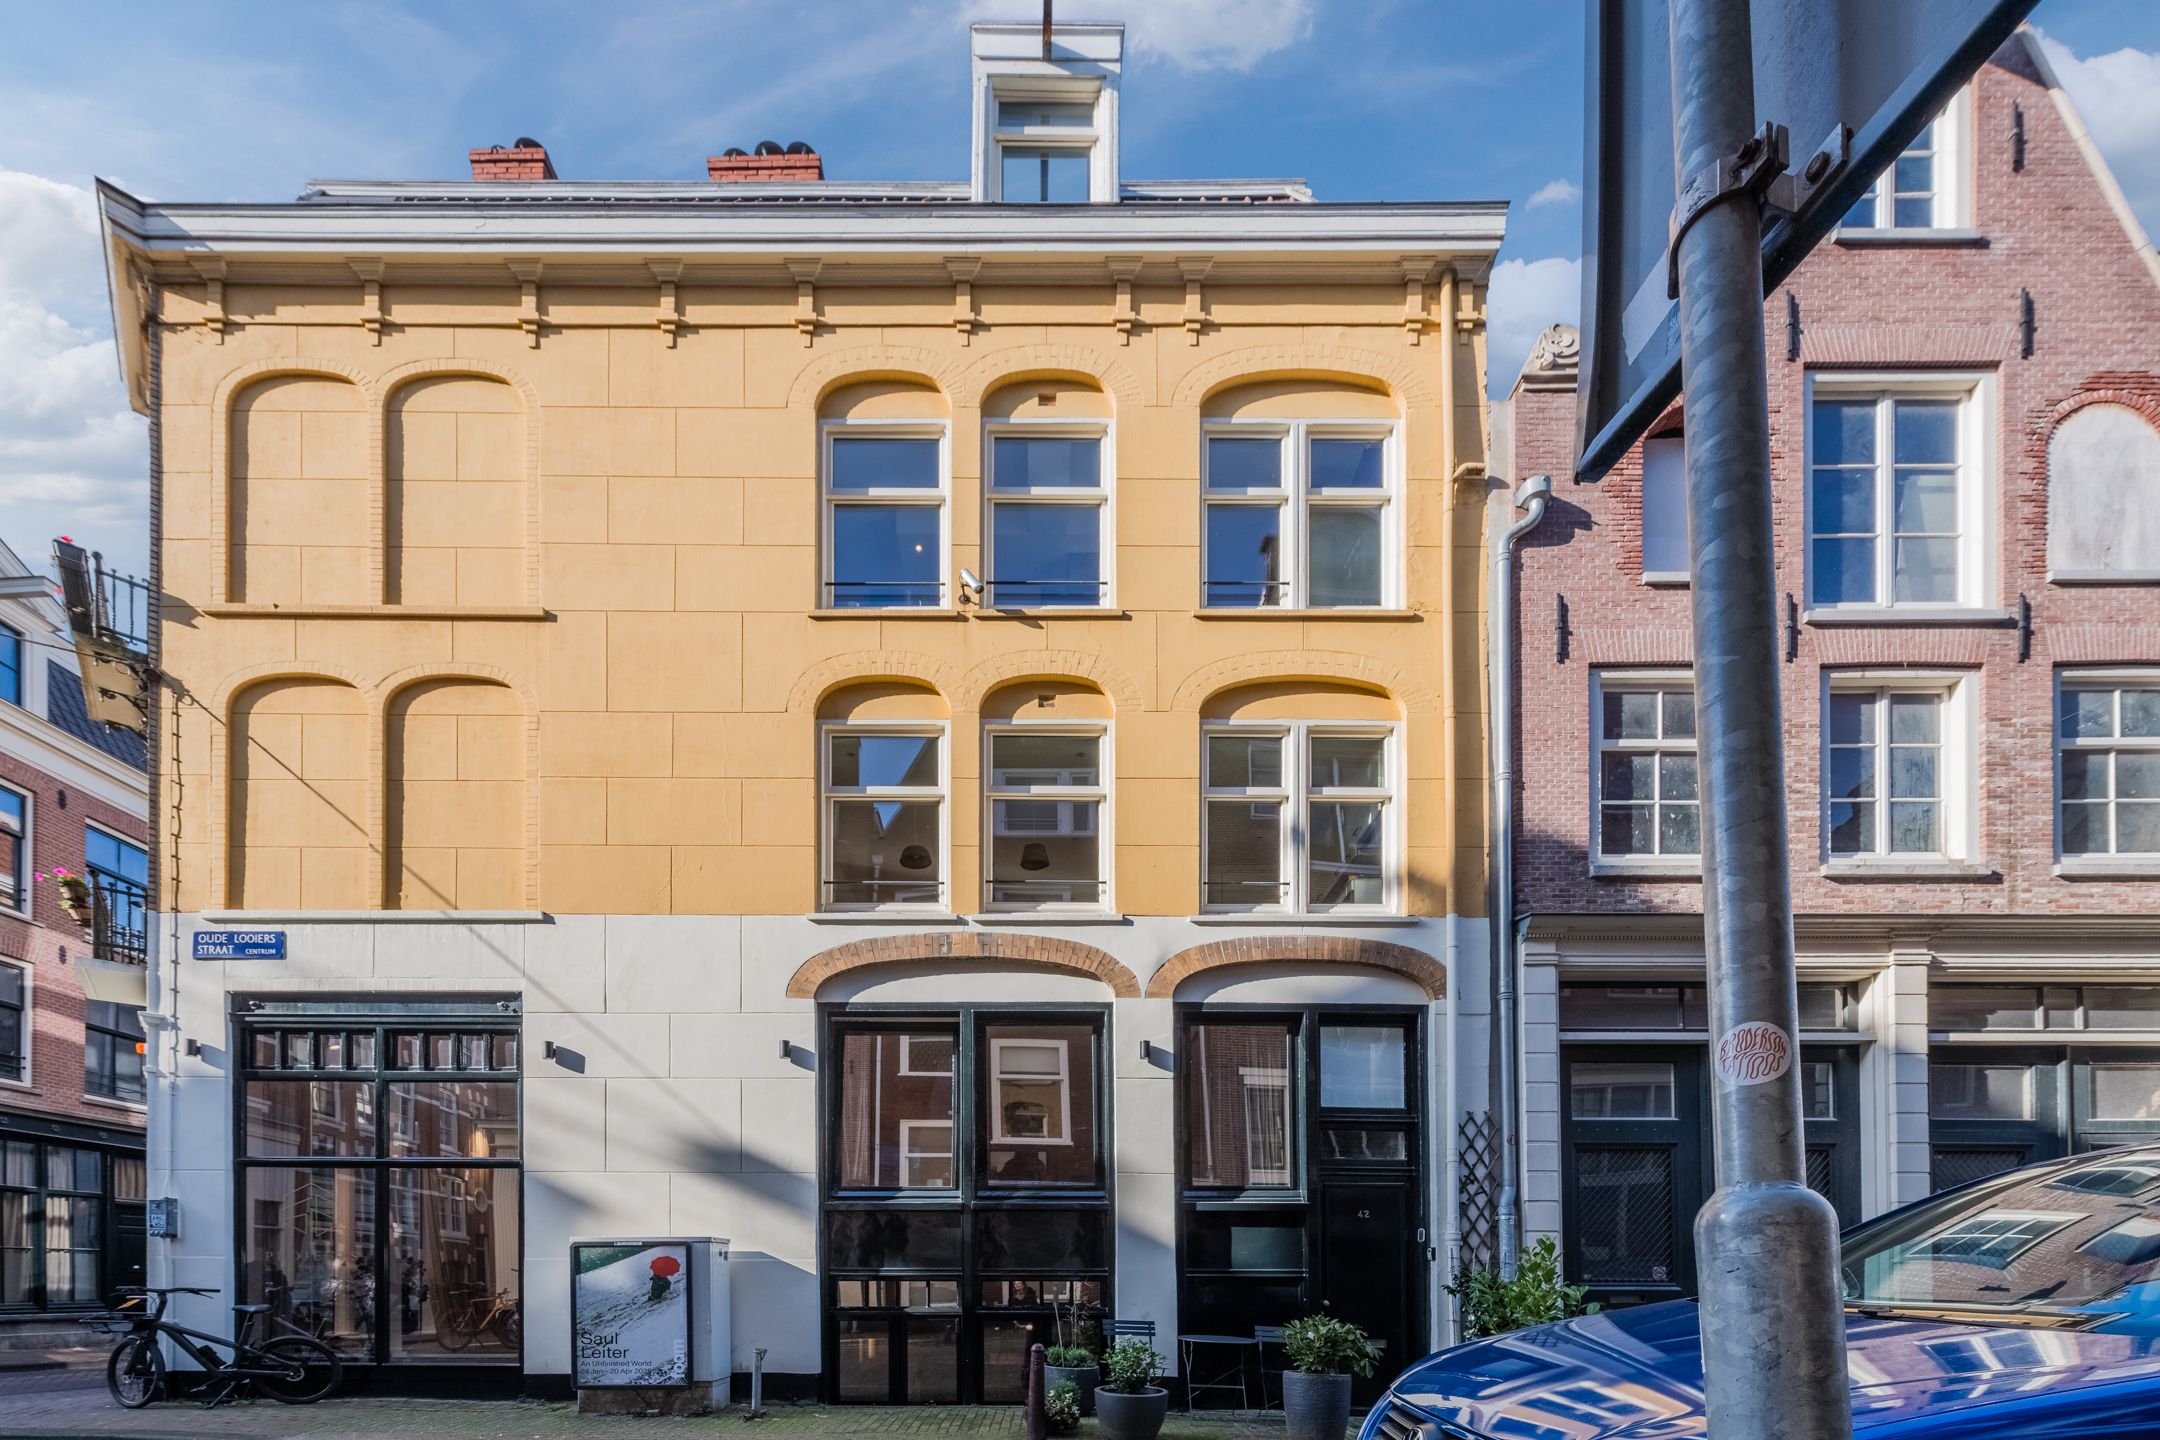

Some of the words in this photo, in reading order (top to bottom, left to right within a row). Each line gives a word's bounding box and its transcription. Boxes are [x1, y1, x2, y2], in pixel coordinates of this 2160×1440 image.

[198, 934, 228, 943] OUDE
[234, 934, 276, 943] LOOIERS
[197, 945, 234, 955] STRAAT
[1719, 1026, 1787, 1061] BRODERSON
[1719, 1050, 1785, 1080] TATTOOS
[1357, 1210, 1370, 1218] 42
[581, 1332, 618, 1345] Saul
[581, 1346, 630, 1359] Leiter
[620, 1368, 633, 1376] Apr
